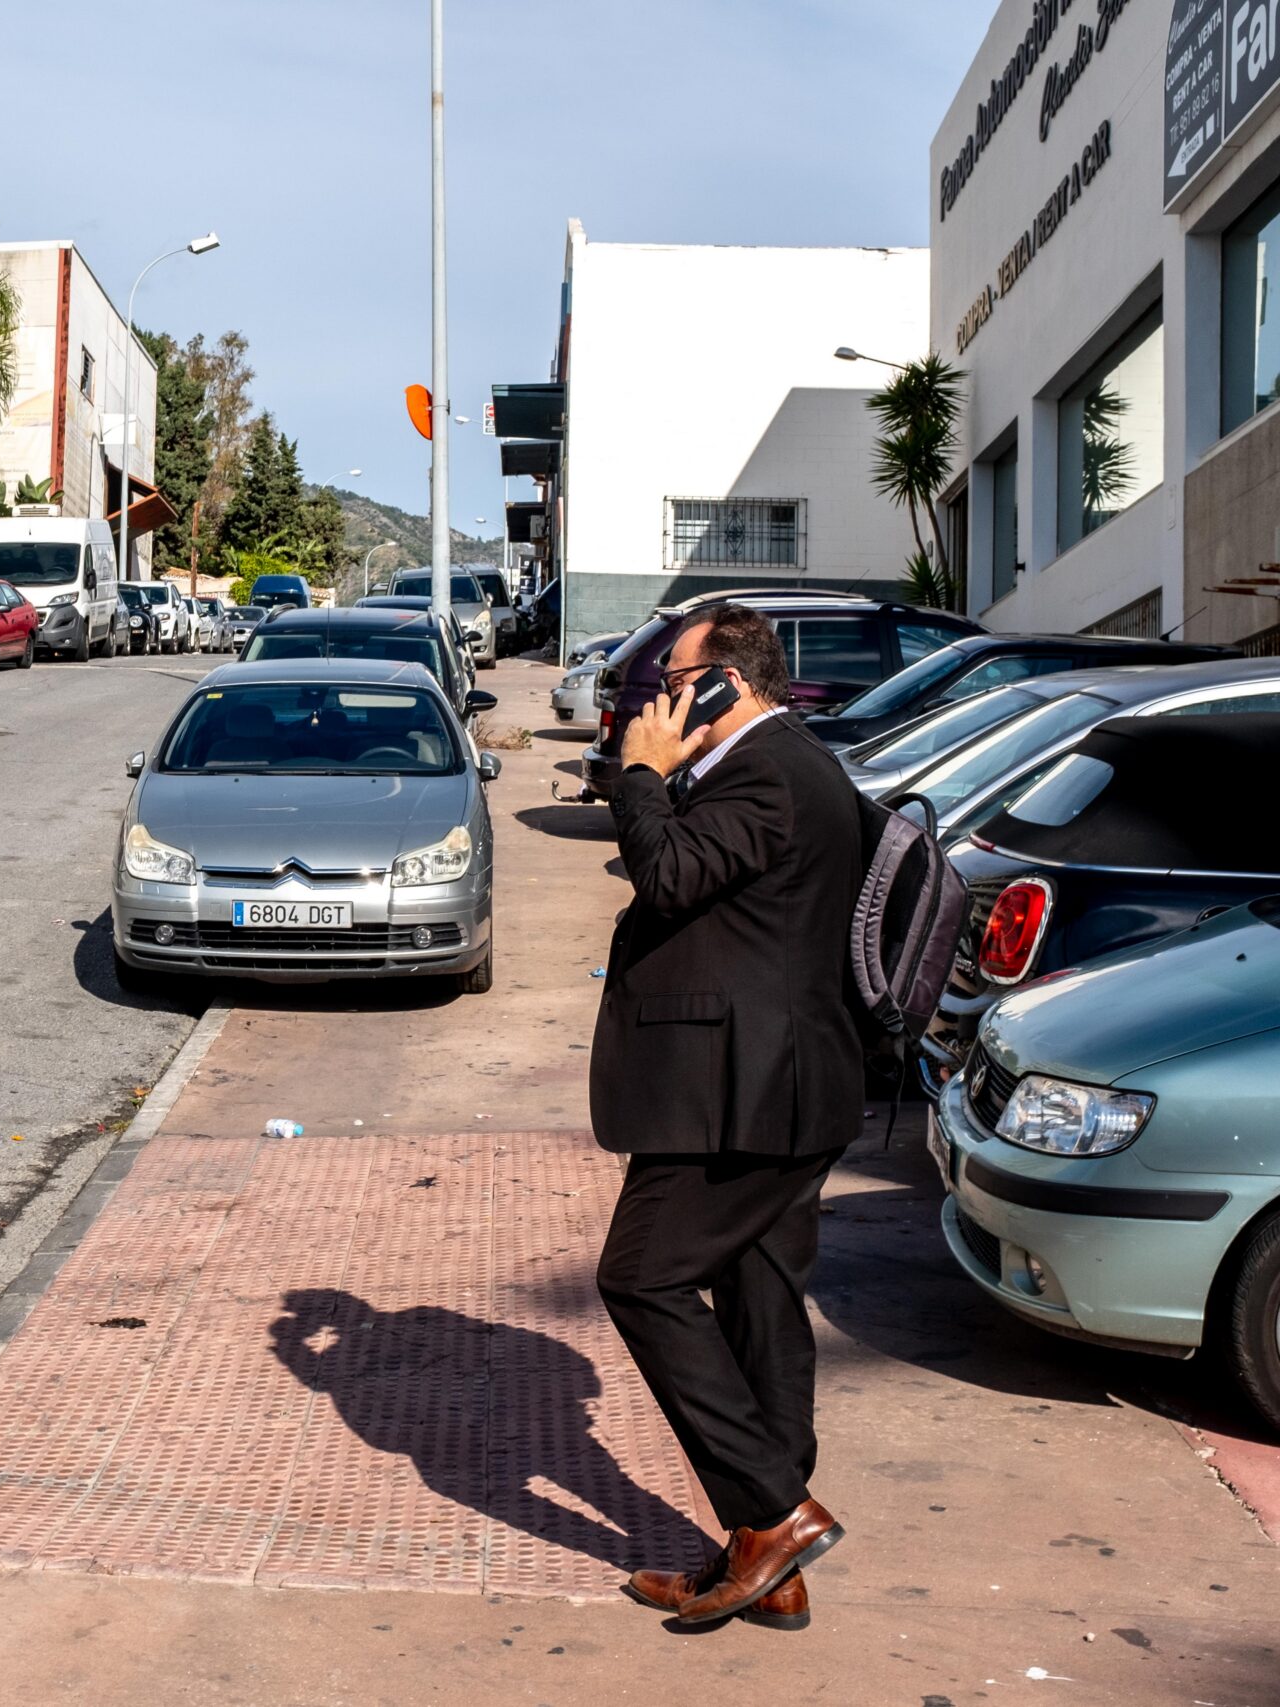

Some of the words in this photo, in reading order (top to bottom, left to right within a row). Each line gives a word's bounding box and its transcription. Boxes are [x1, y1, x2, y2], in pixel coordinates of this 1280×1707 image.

[1166, 45, 1193, 91] COMPRA
[1198, 8, 1222, 48] VENTA
[1173, 77, 1191, 113] RENT
[1191, 71, 1197, 90] A
[1198, 50, 1213, 80] CAR
[1212, 72, 1220, 96] 16
[956, 284, 993, 355] COMPRA
[998, 230, 1032, 299] VENTA
[1037, 174, 1070, 249] RENT
[1069, 162, 1082, 206] A
[1081, 120, 1111, 186] CAR
[249, 904, 299, 924] 6804
[309, 906, 345, 925] DGT
